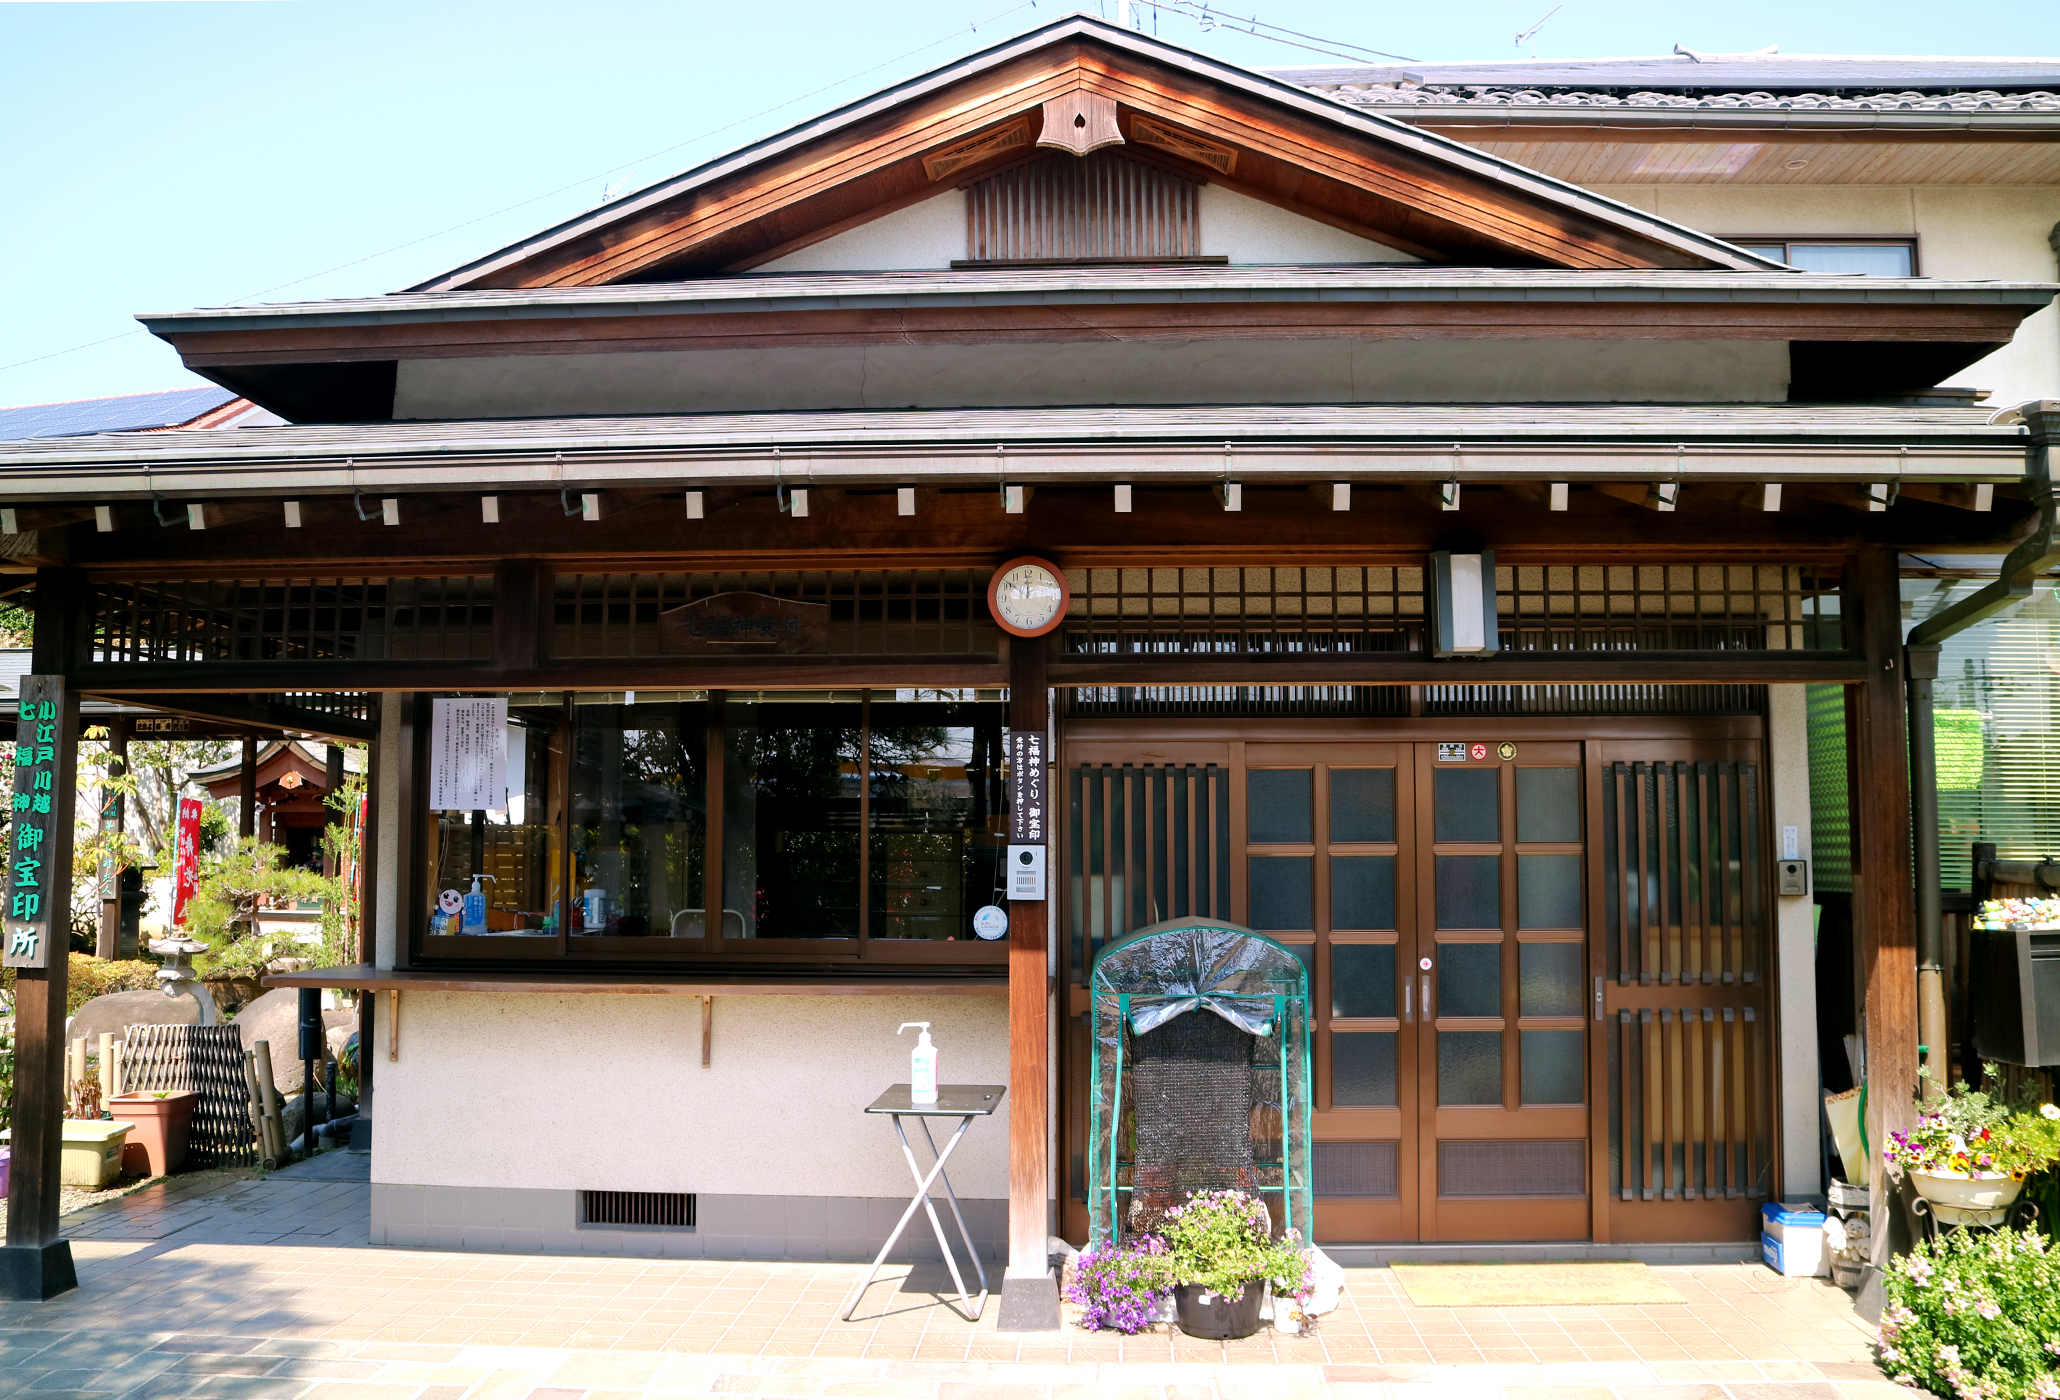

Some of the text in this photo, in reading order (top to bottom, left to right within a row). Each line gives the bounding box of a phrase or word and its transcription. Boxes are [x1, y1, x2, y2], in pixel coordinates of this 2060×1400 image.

[1012, 572, 1019, 581] 11
[1024, 569, 1033, 578] 12
[1039, 572, 1042, 581] 1
[1003, 582, 1012, 590] 10
[1001, 594, 1007, 603] 9
[1050, 592, 1057, 601] 3
[1005, 606, 1012, 614] 8
[1046, 604, 1052, 613] 4
[1015, 614, 1020, 623] 7
[1026, 616, 1033, 626] 6
[1038, 614, 1045, 622] 5
[683, 614, 801, 638] 七福神受付
[12, 701, 36, 814] 七福神
[31, 700, 56, 814] 小江戸川越
[1016, 736, 1024, 839] 受付の方はボタンを押して下さい
[1028, 735, 1040, 840] 七福神めぐり、御宝印
[9, 822, 43, 958] 御宝印所
